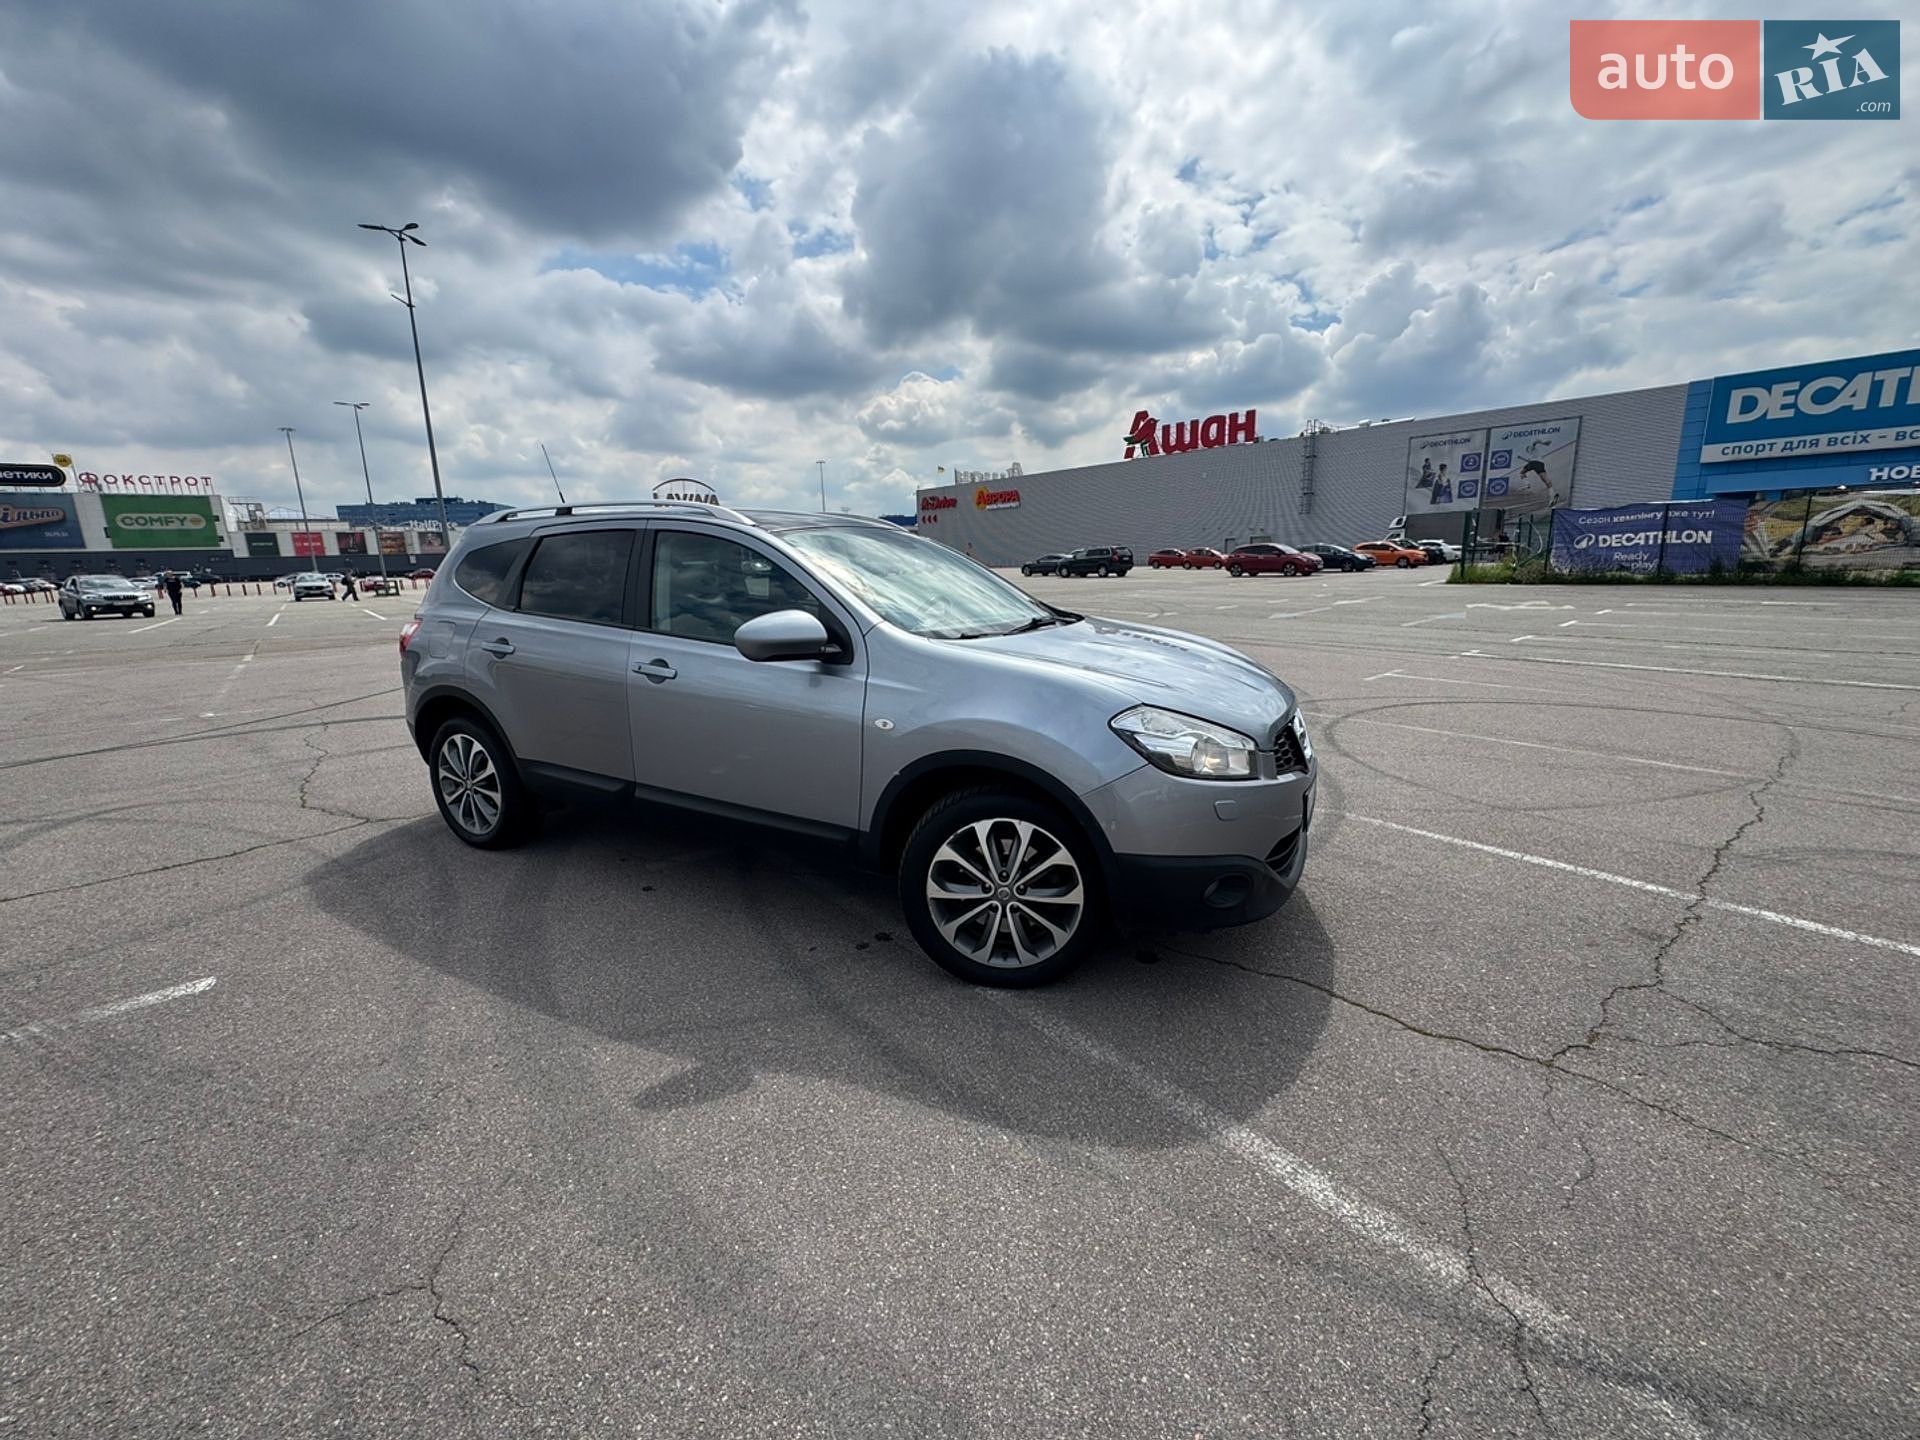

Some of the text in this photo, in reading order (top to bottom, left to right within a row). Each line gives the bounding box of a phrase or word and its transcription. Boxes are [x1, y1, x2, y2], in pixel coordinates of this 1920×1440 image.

[1513, 426, 1561, 438] DECATHLON
[1721, 442, 1777, 457] спорт
[1781, 438, 1820, 452] для
[1827, 431, 1871, 447] всіх
[0, 470, 53, 480] етики
[78, 472, 212, 486] ФОКСТРОТ
[120, 516, 189, 526] COMFY
[1599, 529, 1712, 548] DECATHLON
